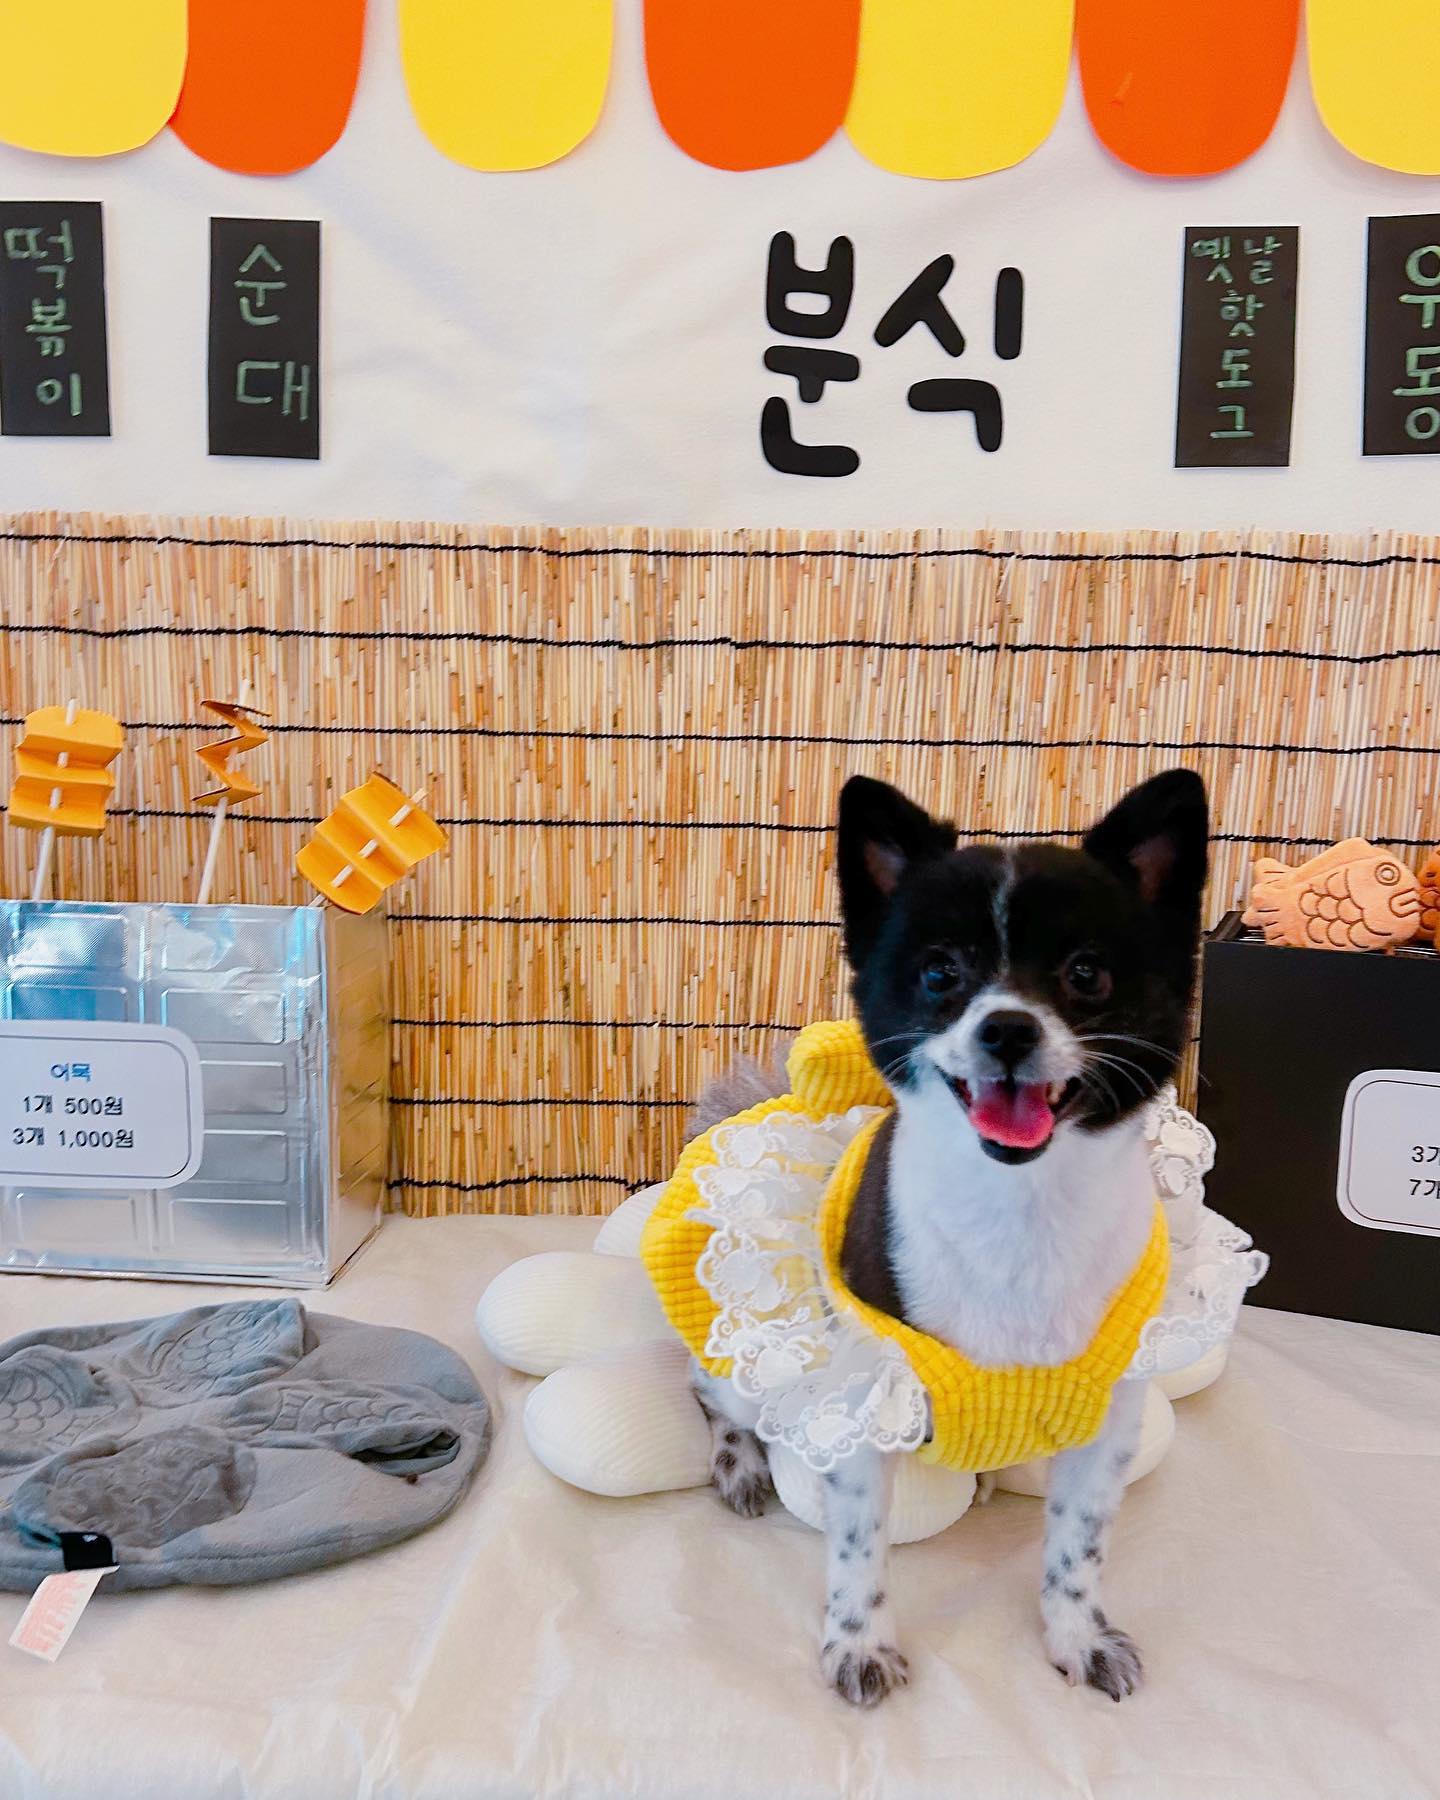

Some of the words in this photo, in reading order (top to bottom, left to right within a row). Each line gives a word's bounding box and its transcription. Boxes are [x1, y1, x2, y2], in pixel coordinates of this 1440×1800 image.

[1191, 235, 1283, 285] 옛날
[3, 219, 83, 416] 떡볶이
[233, 243, 311, 421] 순대
[760, 230, 1023, 477] 분식
[1209, 288, 1266, 439] 핫도그
[23, 1094, 53, 1114] 1개
[64, 1096, 123, 1116] 500원
[50, 1062, 92, 1082] 어묵
[12, 1127, 45, 1146] 3개
[58, 1129, 134, 1149] 1,000원
